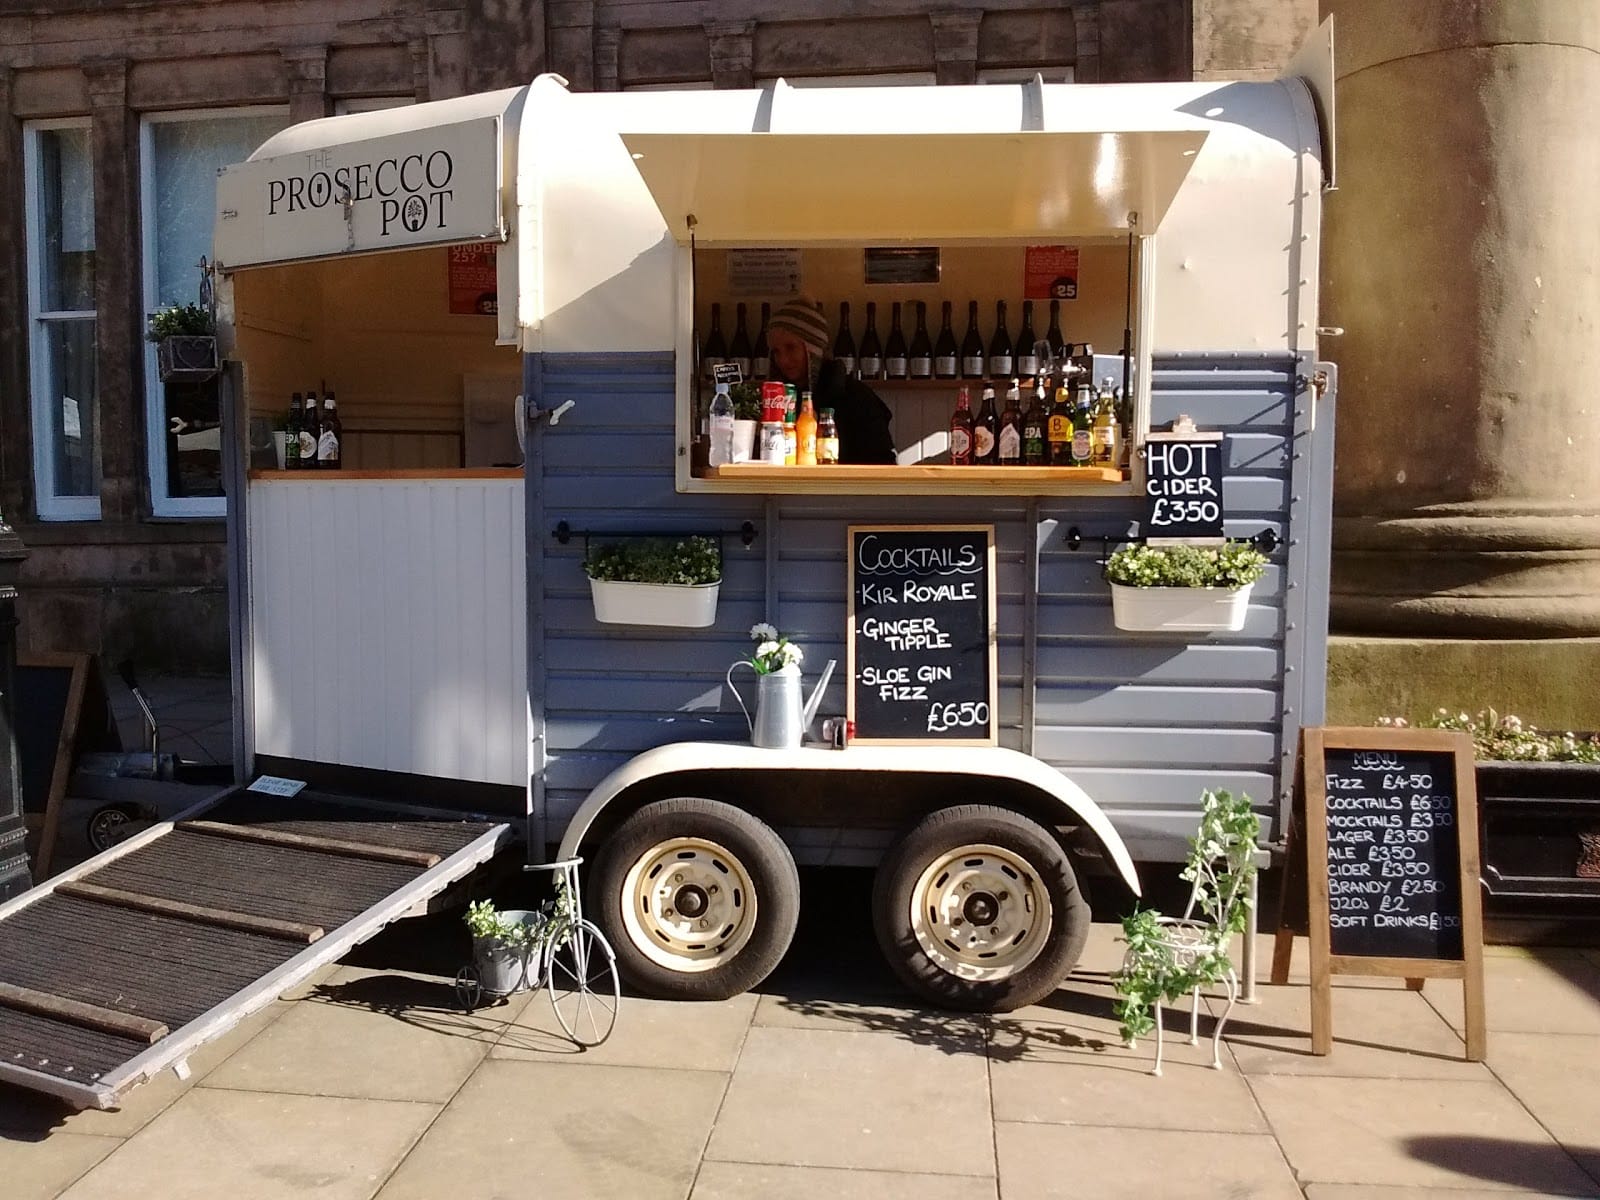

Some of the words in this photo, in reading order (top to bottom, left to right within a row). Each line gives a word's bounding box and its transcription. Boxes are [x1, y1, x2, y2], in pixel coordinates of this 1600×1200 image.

[306, 150, 333, 172] THE
[267, 150, 453, 216] PROSECCO
[380, 190, 453, 236] POT
[1057, 285, 1076, 297] 25
[1024, 427, 1042, 439] EPA
[1147, 444, 1217, 476] HOT
[1147, 477, 1217, 497] CIDER
[859, 535, 976, 571] COCKTAILS
[904, 580, 977, 603] ROYALE
[884, 633, 952, 651] TIPPLE
[917, 666, 952, 684] GIN
[879, 685, 928, 701] FIZZ
[1353, 752, 1398, 766] MENU
[1325, 774, 1365, 790] FIZZ
[1325, 795, 1403, 810] COCKTAILS
[1326, 814, 1403, 828] MOCKTAILS
[1327, 830, 1376, 844] LAGER
[1327, 846, 1356, 860] ALE
[1327, 863, 1371, 877] CIDER
[1328, 878, 1392, 895] BRANDY
[1379, 894, 1410, 912] £2
[1329, 913, 1368, 928] SOFT
[1373, 913, 1429, 928] DRINKS
